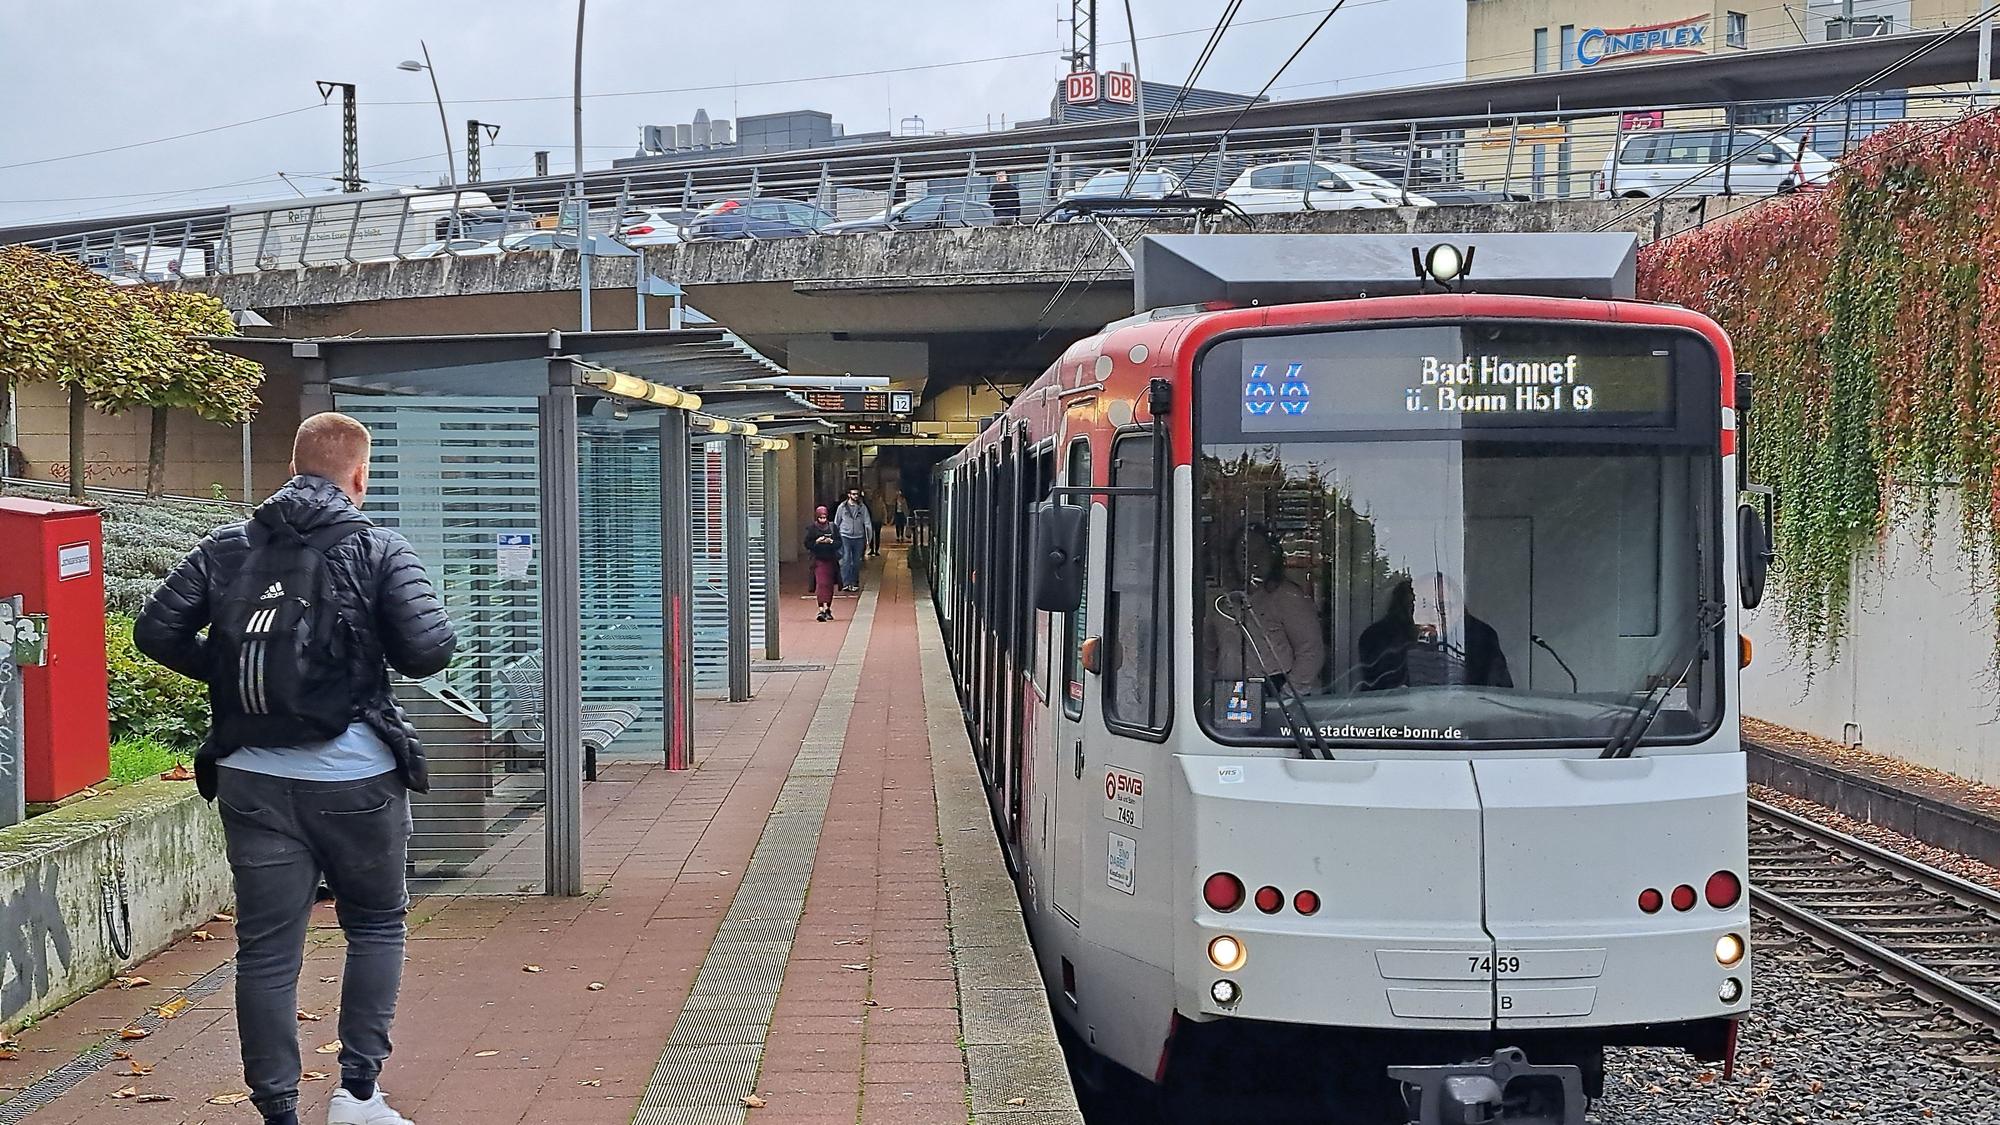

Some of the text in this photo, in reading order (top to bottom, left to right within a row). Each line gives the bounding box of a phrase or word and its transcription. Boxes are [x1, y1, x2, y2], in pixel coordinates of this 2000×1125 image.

[1577, 22, 1709, 66] CINEPLEX
[1070, 76, 1094, 99] DB
[1111, 75, 1132, 98] DB
[1421, 354, 1577, 385] Bad Honnef
[1245, 363, 1310, 415] 66
[1406, 387, 1429, 411] ü.
[1438, 386, 1507, 411] Bonn
[1515, 386, 1562, 411] Hbf
[896, 400, 908, 410] 12
[1280, 724, 1462, 739] wwstadtwerke-bonn.de
[1117, 774, 1143, 796] SWB
[1118, 806, 1134, 825] 7459
[1501, 996, 1513, 1010] B
